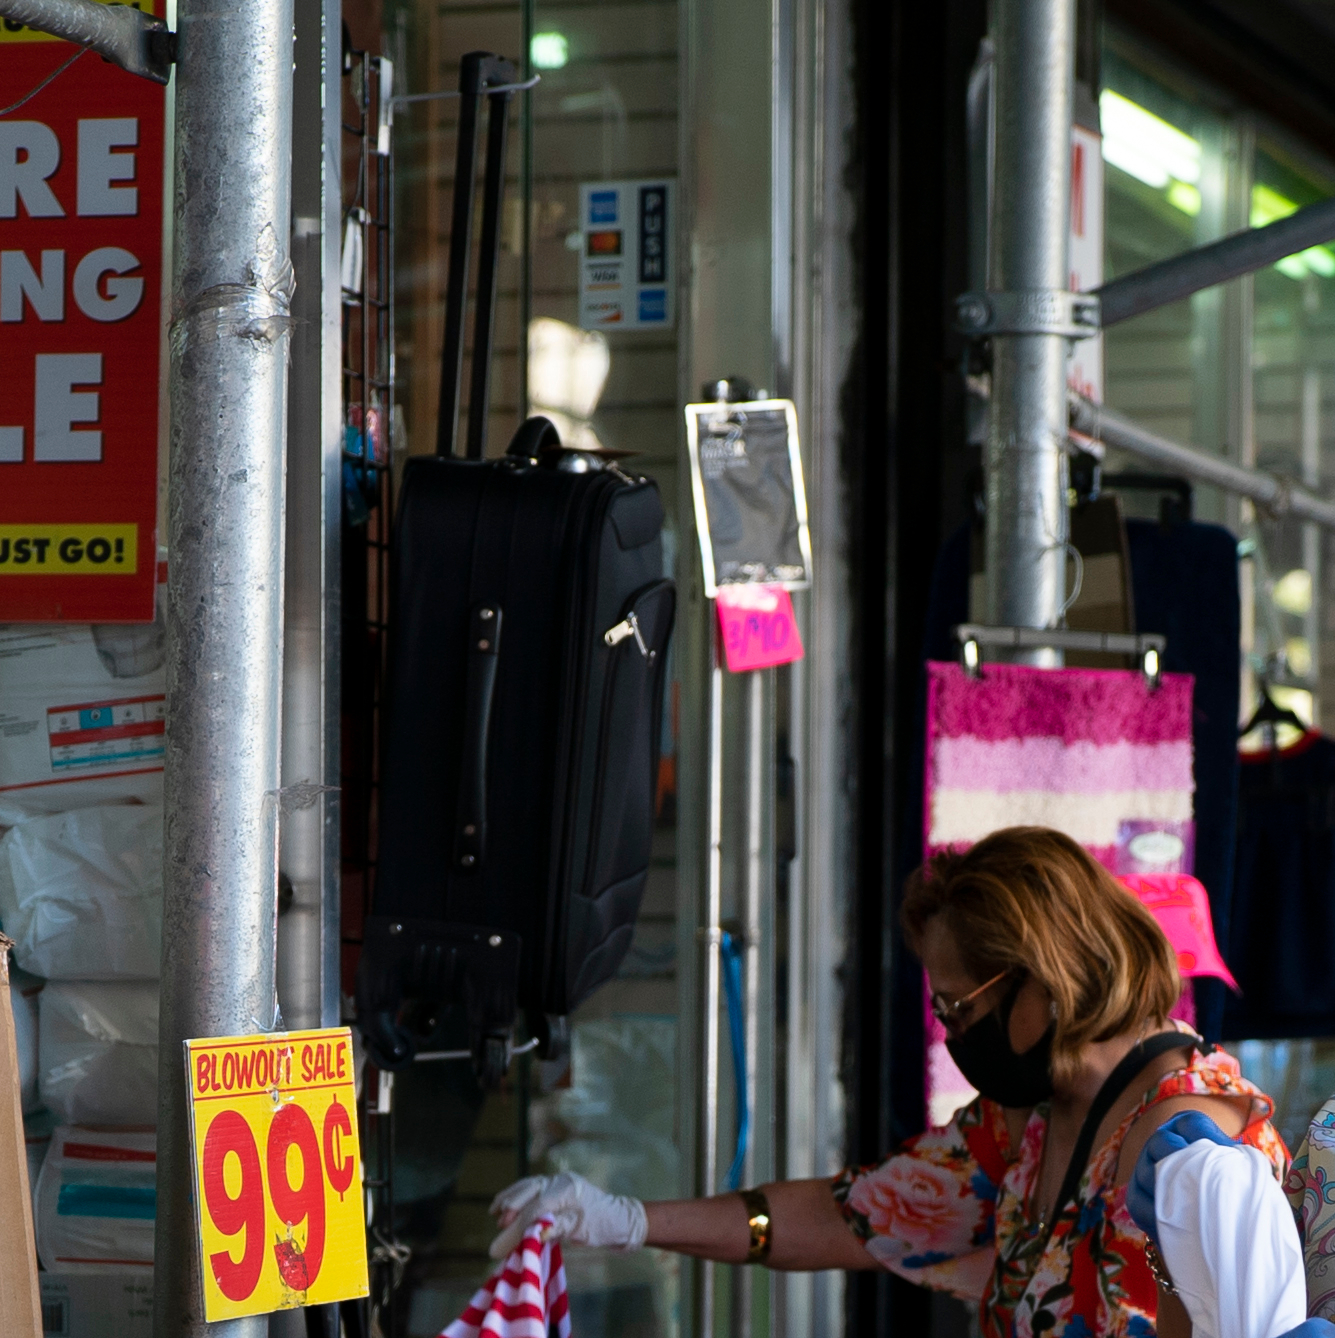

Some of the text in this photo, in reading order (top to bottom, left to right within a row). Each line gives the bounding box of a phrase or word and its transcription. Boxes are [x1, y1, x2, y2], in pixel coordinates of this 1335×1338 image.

[644, 192, 661, 279] PUSH
[58, 538, 125, 564] GO!
[196, 1040, 347, 1094] BLOWOUT SALE
